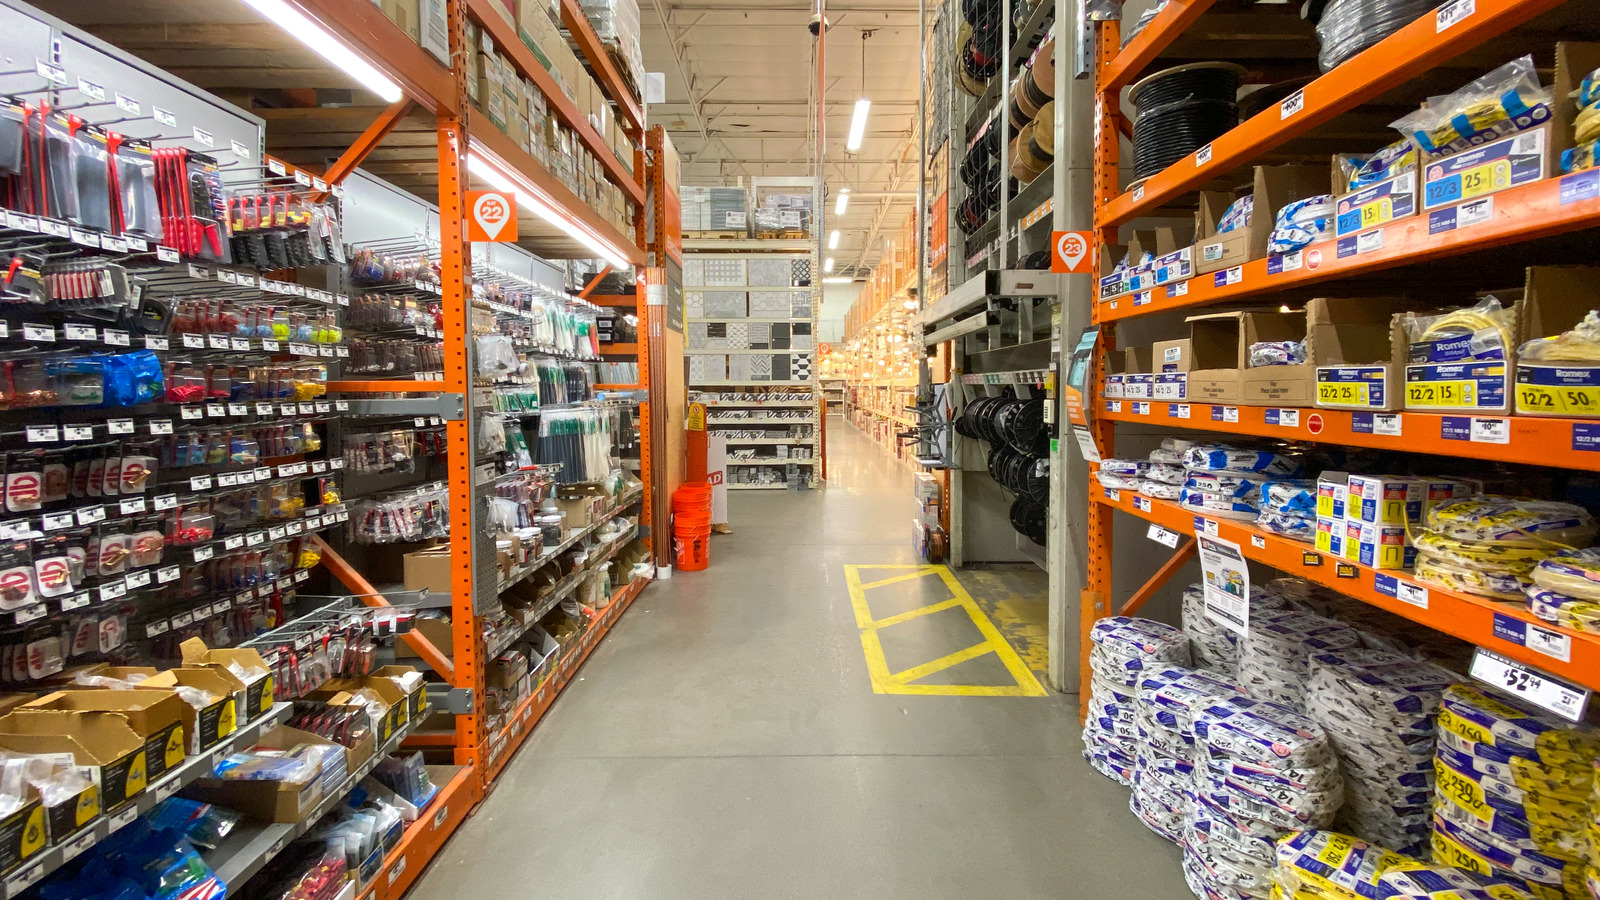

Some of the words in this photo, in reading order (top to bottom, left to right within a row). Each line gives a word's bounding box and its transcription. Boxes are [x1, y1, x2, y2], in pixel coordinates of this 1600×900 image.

[1464, 172, 1480, 188] 25
[1428, 182, 1458, 200] 12/3
[481, 206, 503, 219] 22
[1363, 207, 1373, 220] 15
[1338, 214, 1361, 230] 12/3
[1064, 243, 1082, 255] 23
[1435, 339, 1471, 352] Rome
[1555, 369, 1590, 378] Romex
[1320, 388, 1338, 398] 12/2
[1342, 387, 1351, 398] 25
[1409, 388, 1434, 400] 12/2
[1440, 386, 1452, 398] 15
[1522, 391, 1555, 406] 12/2
[1567, 391, 1589, 406] 50
[1197, 481, 1213, 489] 250
[1164, 690, 1182, 699] 250
[1232, 720, 1255, 731] 250
[1263, 731, 1293, 745] 14/2
[1458, 723, 1482, 744] 250
[1214, 738, 1232, 749] 250
[1451, 775, 1474, 797] 250
[1458, 829, 1491, 852] Romex
[1454, 849, 1479, 873] 250
